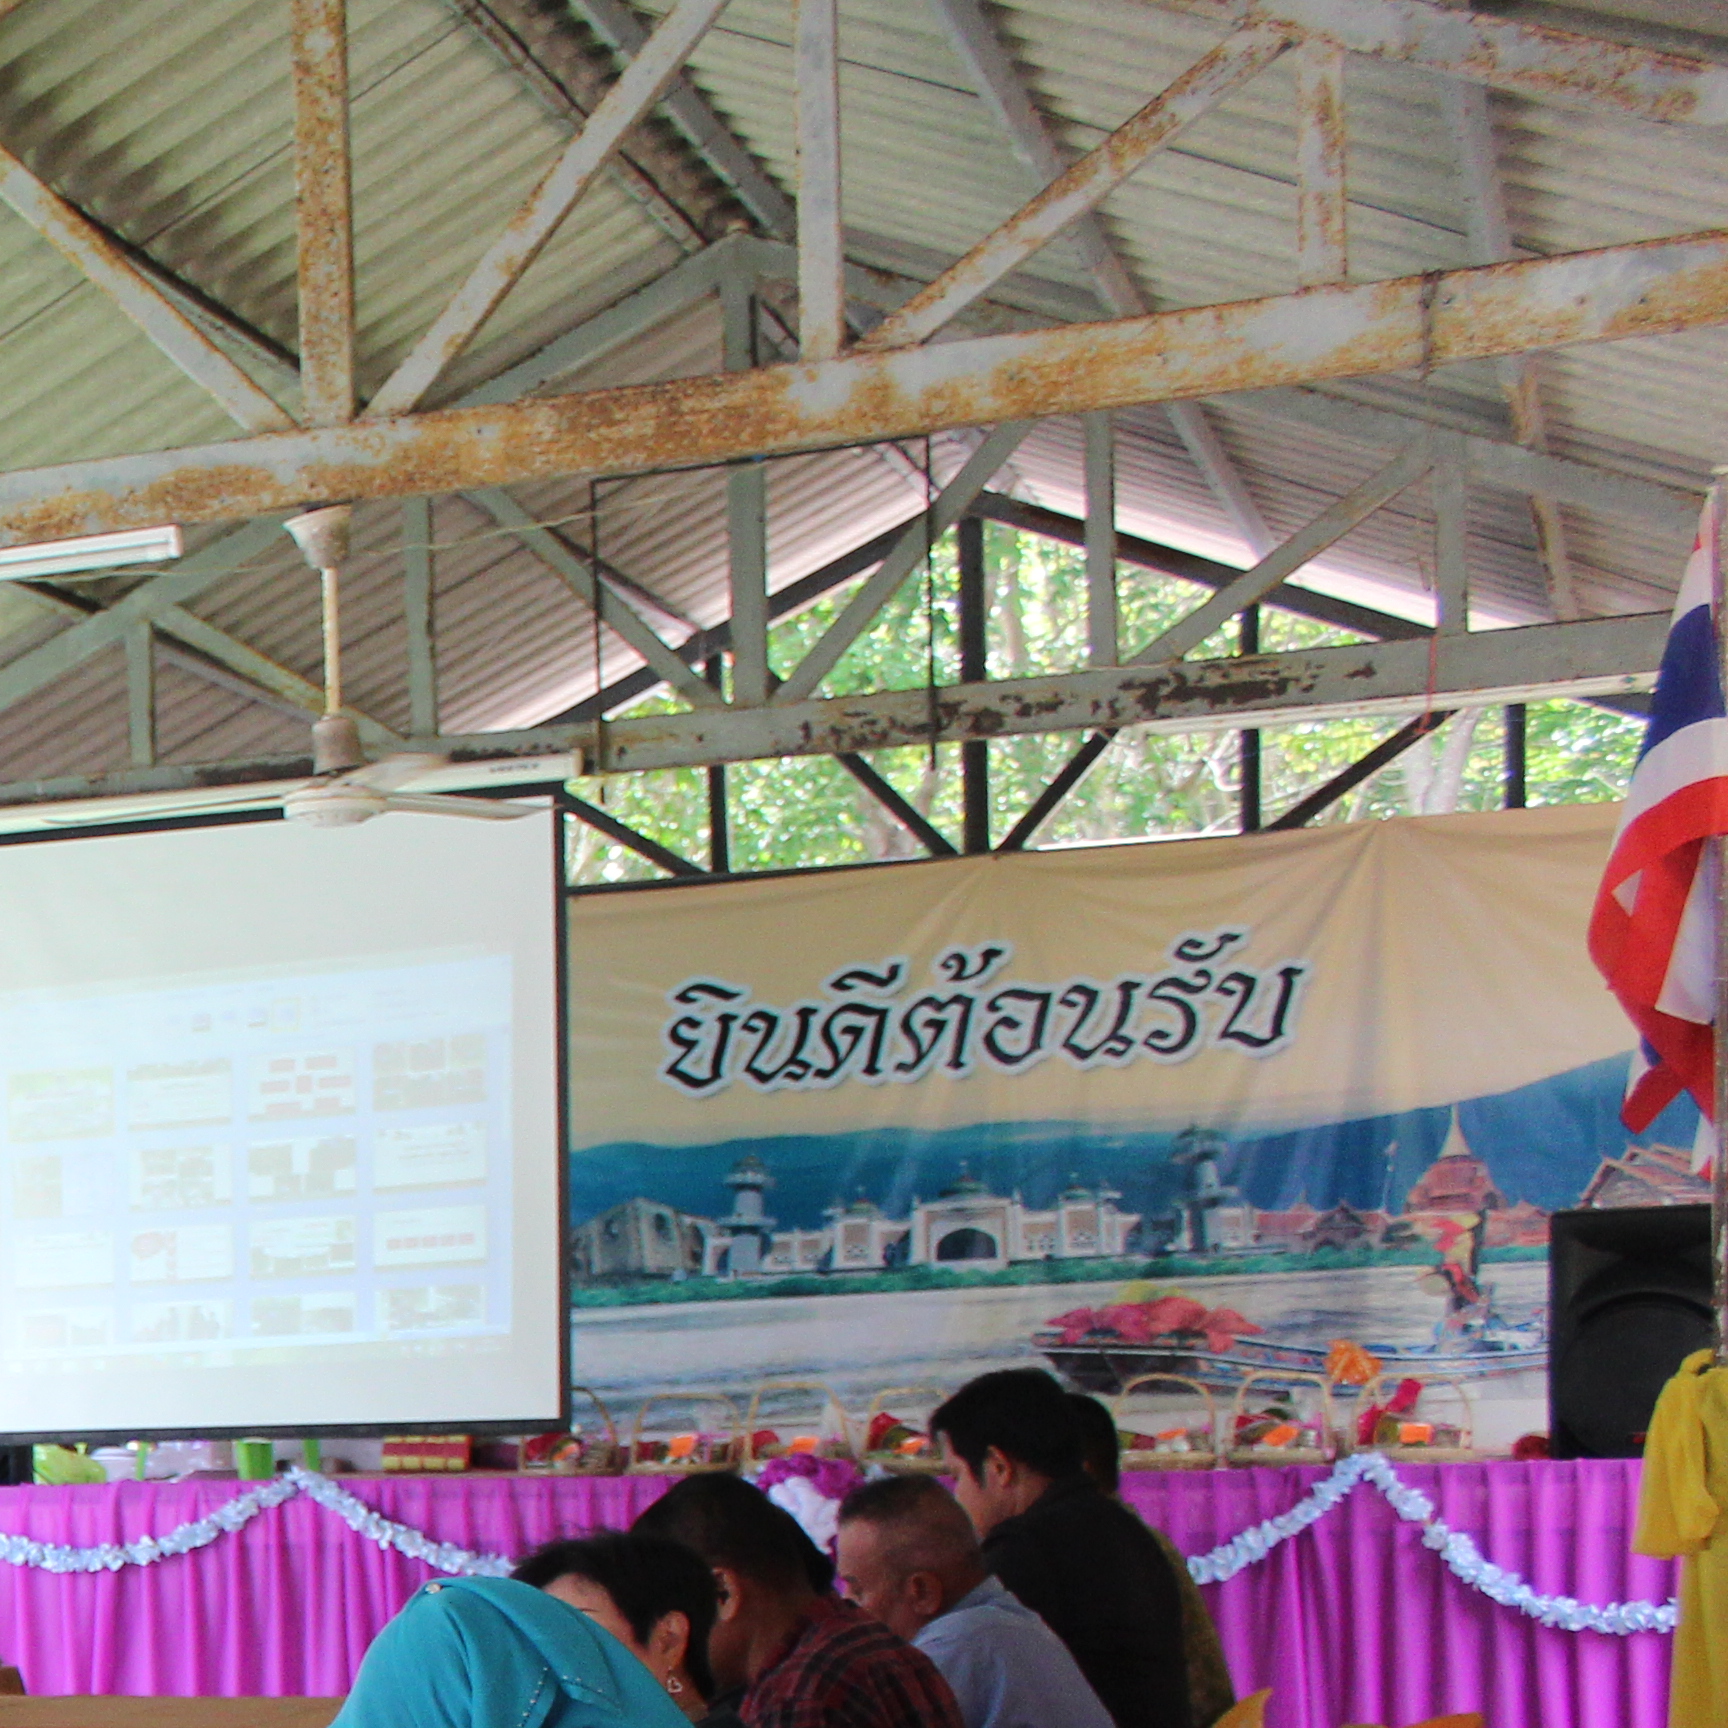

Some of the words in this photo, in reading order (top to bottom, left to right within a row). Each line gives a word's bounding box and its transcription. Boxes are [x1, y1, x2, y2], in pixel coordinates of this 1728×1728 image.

[666, 933, 1303, 1089] ยินดีต้อนรับ
